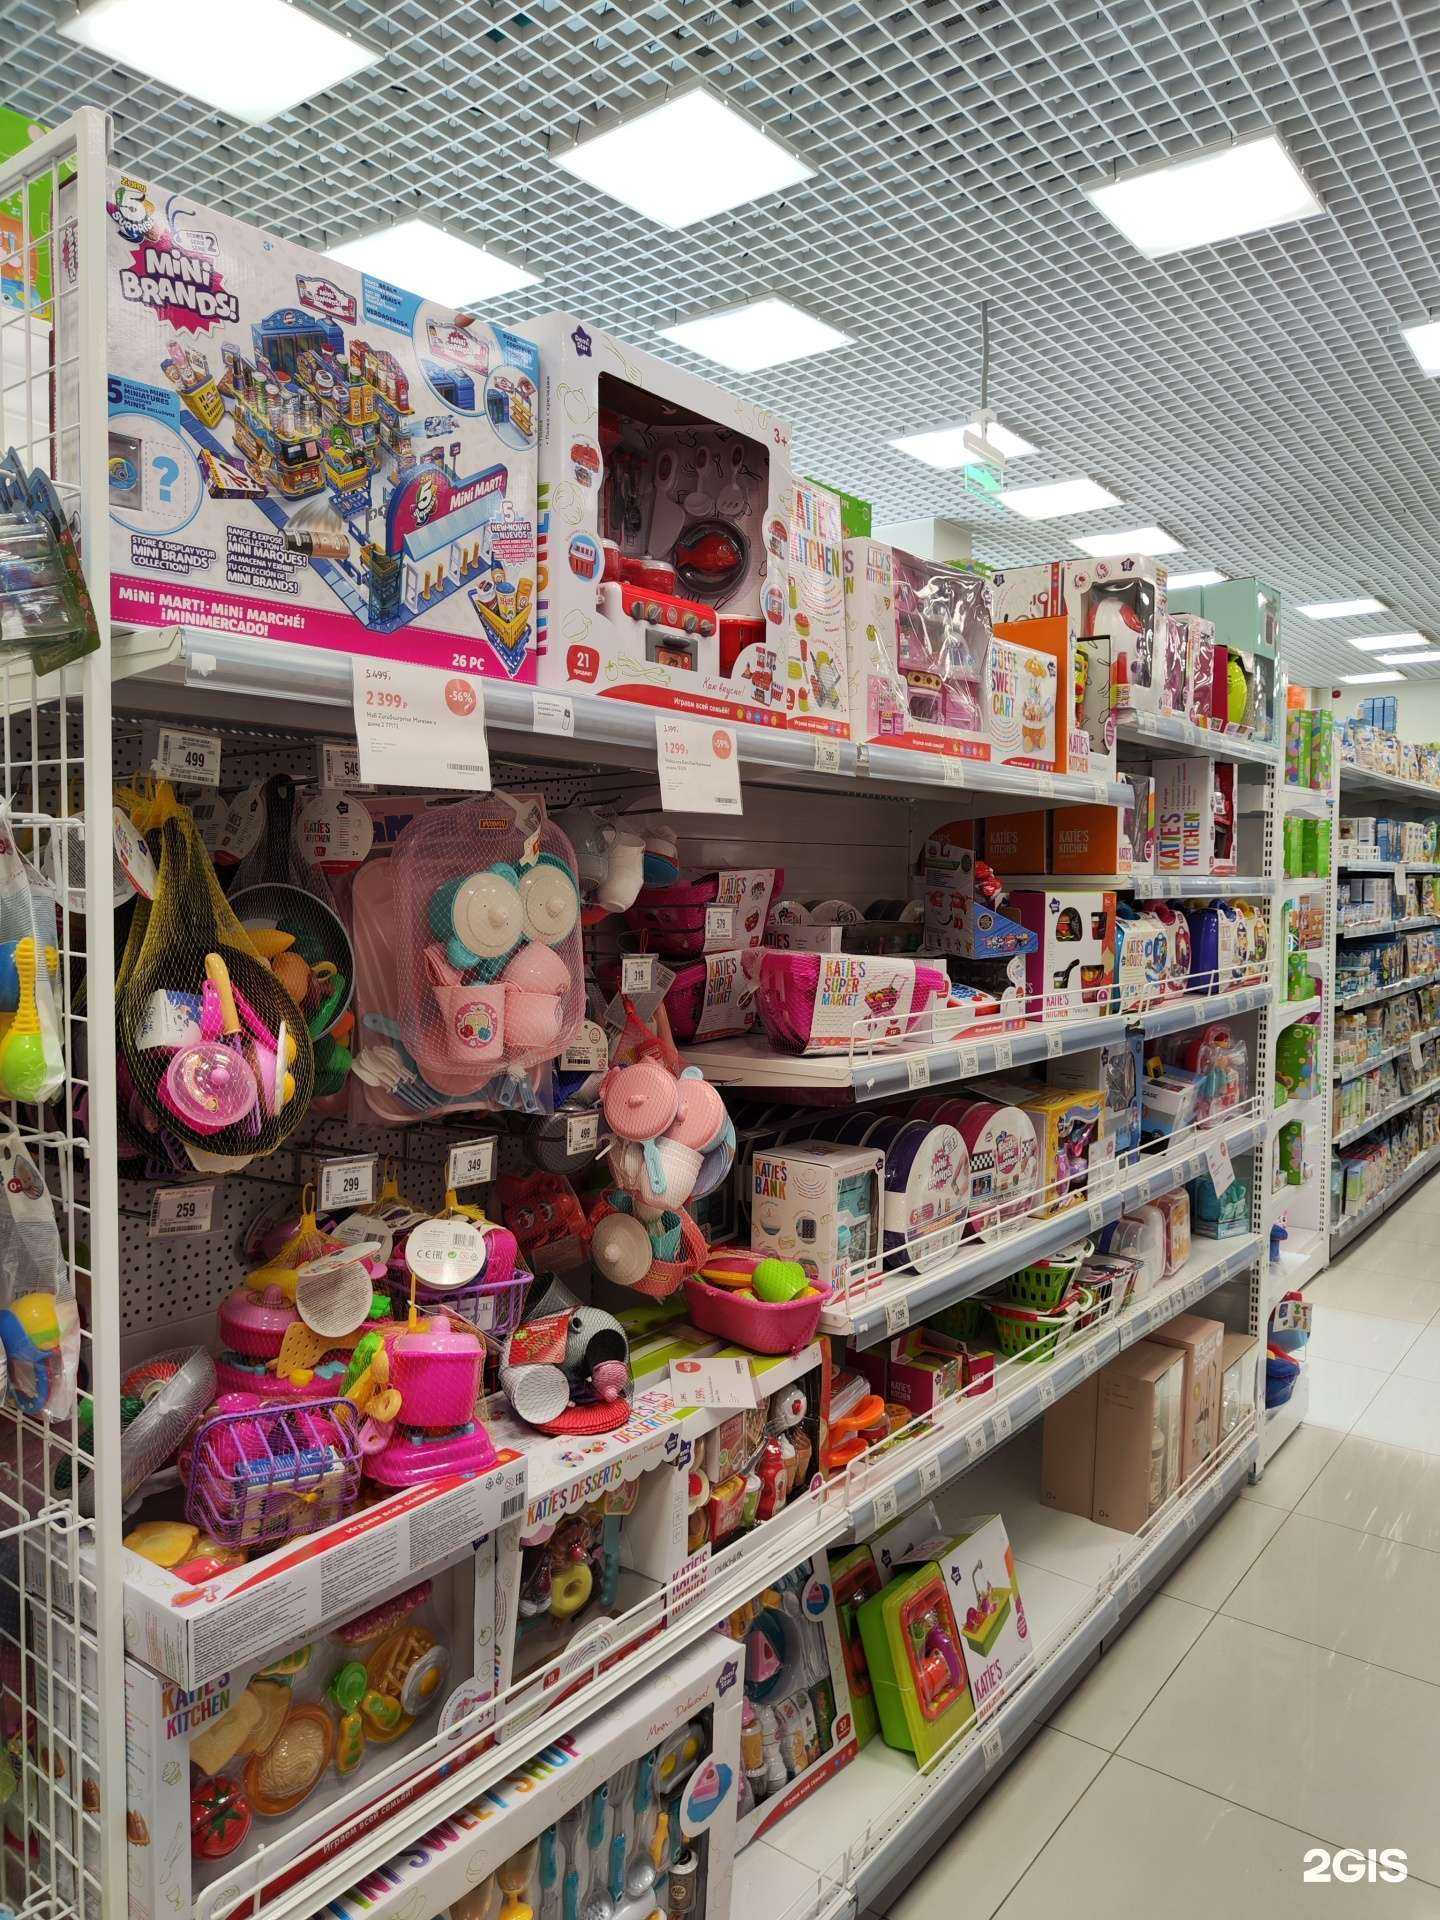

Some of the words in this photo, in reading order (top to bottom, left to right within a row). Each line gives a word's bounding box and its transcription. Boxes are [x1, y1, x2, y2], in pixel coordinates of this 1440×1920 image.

[120, 268, 239, 322] BRANDS!
[107, 379, 123, 404] 5
[774, 429, 787, 447] 3+
[474, 476, 502, 499] MART!
[228, 527, 251, 539] RANGE
[258, 533, 283, 545] EXPOSE
[228, 535, 237, 543] TA
[238, 536, 281, 551] COLLECTION
[132, 536, 157, 548] STORE
[164, 543, 193, 557] DISPLAY
[193, 549, 216, 560] YOUR
[132, 545, 159, 558] MINI
[161, 549, 210, 569] BRANDS
[228, 541, 251, 555] MINI
[253, 546, 308, 567] MARQUES!
[132, 556, 190, 574] COLLECTION!
[228, 563, 237, 571] TU
[228, 571, 251, 584] MINI
[253, 575, 299, 594] BRANDS!
[159, 594, 205, 612] MART!
[247, 609, 305, 630] MARCHÉ!
[161, 608, 269, 637] ¡MINIMERCADO!
[452, 653, 467, 668] 26
[470, 656, 486, 671] PC
[577, 652, 591, 669] 21
[449, 691, 473, 704] -56%
[673, 697, 695, 709] Играем
[184, 751, 206, 769] 499
[303, 820, 331, 835] KATIE'S
[1058, 829, 1090, 844] KATIE'S
[1159, 812, 1181, 871] KATIE'S
[1183, 812, 1201, 867] KITCHEN
[1058, 843, 1089, 855] KITCHEN
[720, 876, 748, 896] KATIE'S
[710, 956, 738, 978] KATIE'S
[826, 959, 867, 978] KATIE'S
[708, 975, 733, 993] SUPER
[824, 978, 860, 993] SUPER
[706, 990, 732, 1007] MARKET
[821, 993, 859, 1007] MARKET
[1046, 994, 1069, 1008] KATIE'S
[467, 1159, 482, 1173] 349
[755, 1159, 788, 1182] KATIE'S
[343, 1177, 360, 1192] 299
[755, 1177, 787, 1200] BANK
[176, 1203, 196, 1218] 259
[612, 1413, 674, 1444] DESSERTS
[527, 1487, 568, 1527] KATIE'S
[570, 1460, 624, 1508] DESSERTS
[974, 1659, 1003, 1702] KATIE'S
[166, 1688, 230, 1740] KITCHEN
